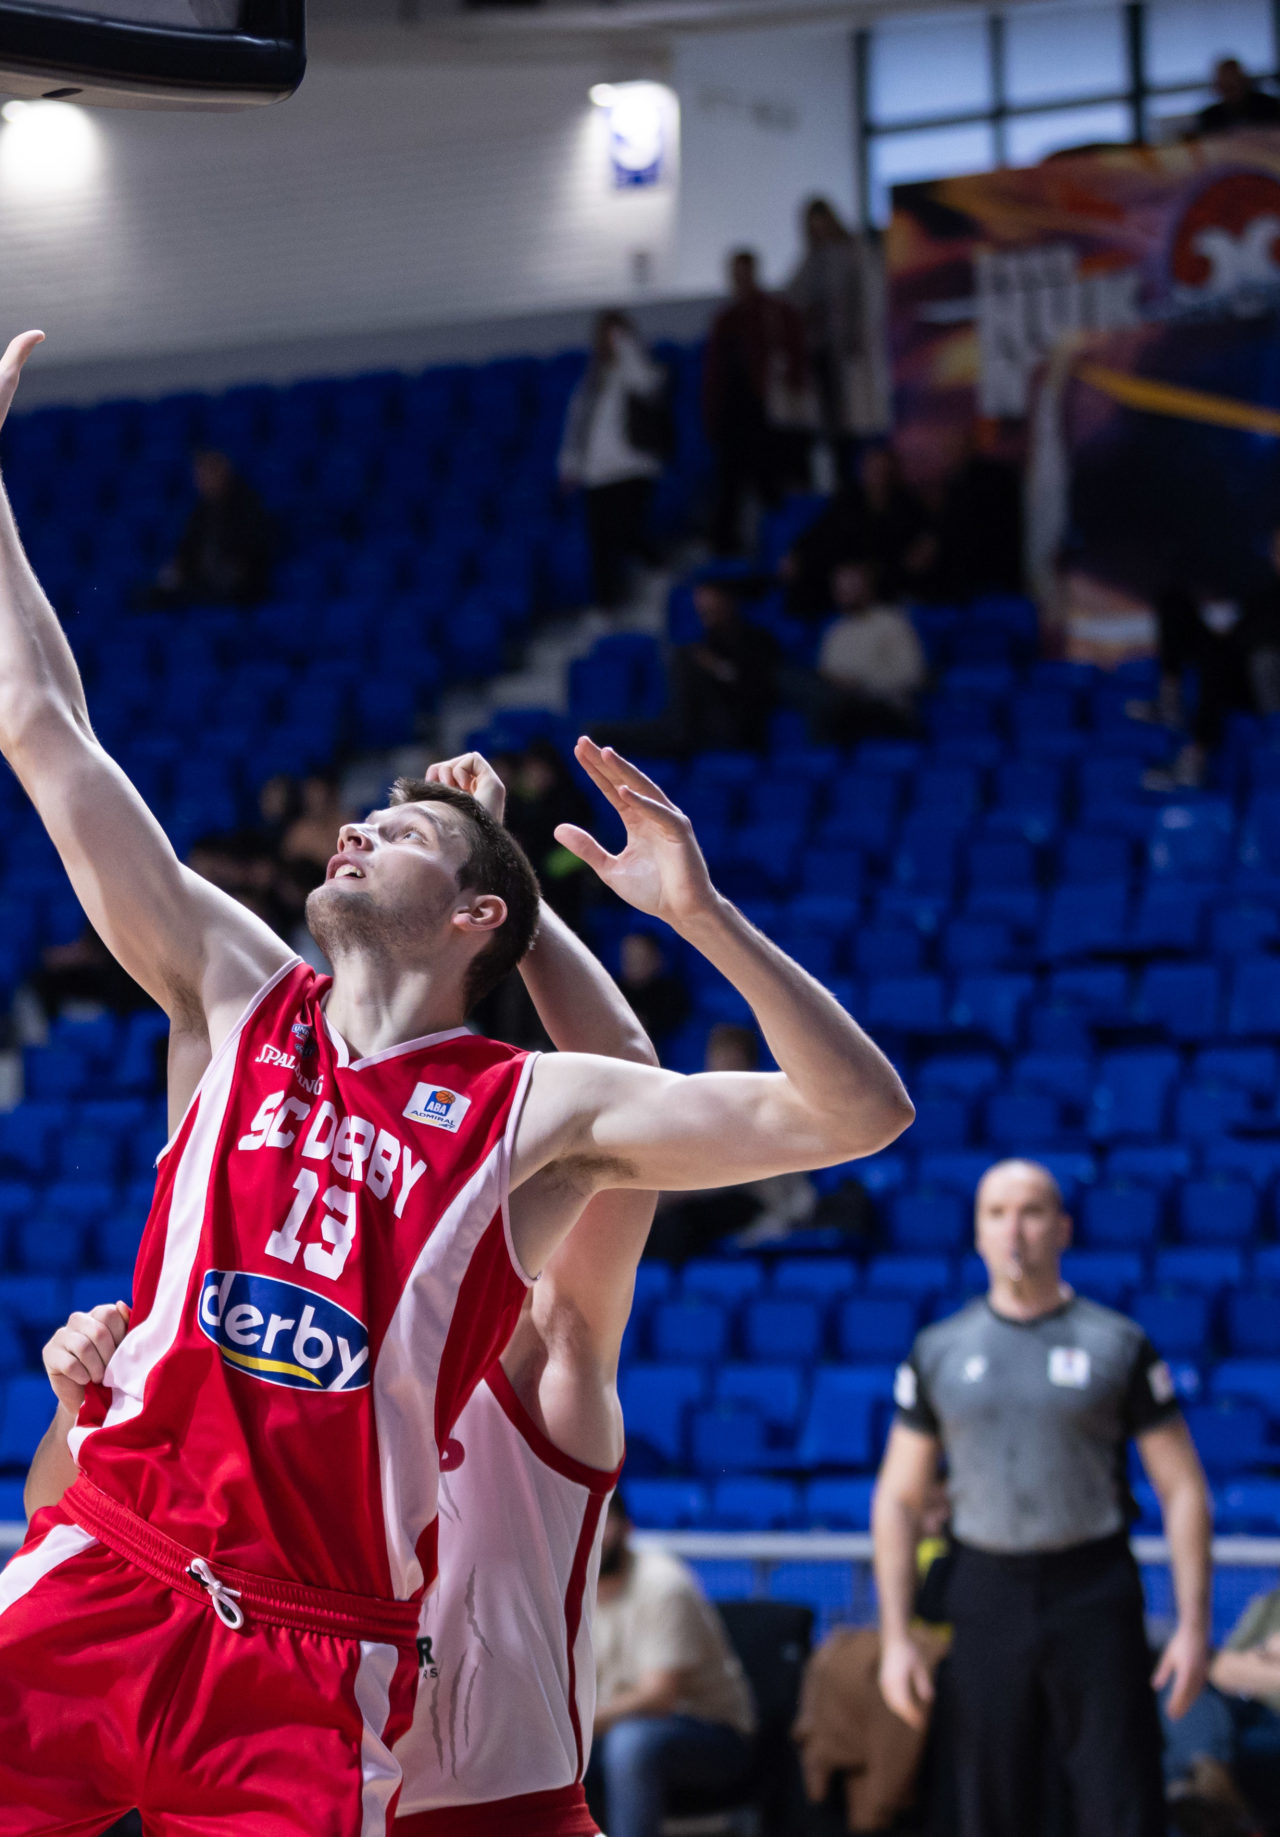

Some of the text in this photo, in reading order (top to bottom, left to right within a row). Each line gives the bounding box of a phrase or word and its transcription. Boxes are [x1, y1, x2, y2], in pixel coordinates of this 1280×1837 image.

[237, 1090, 428, 1220] SC DERBY
[410, 1109, 456, 1126] ADMIRAL
[426, 1101, 448, 1115] ABA
[264, 1167, 357, 1282] 13
[201, 1271, 369, 1391] derby
